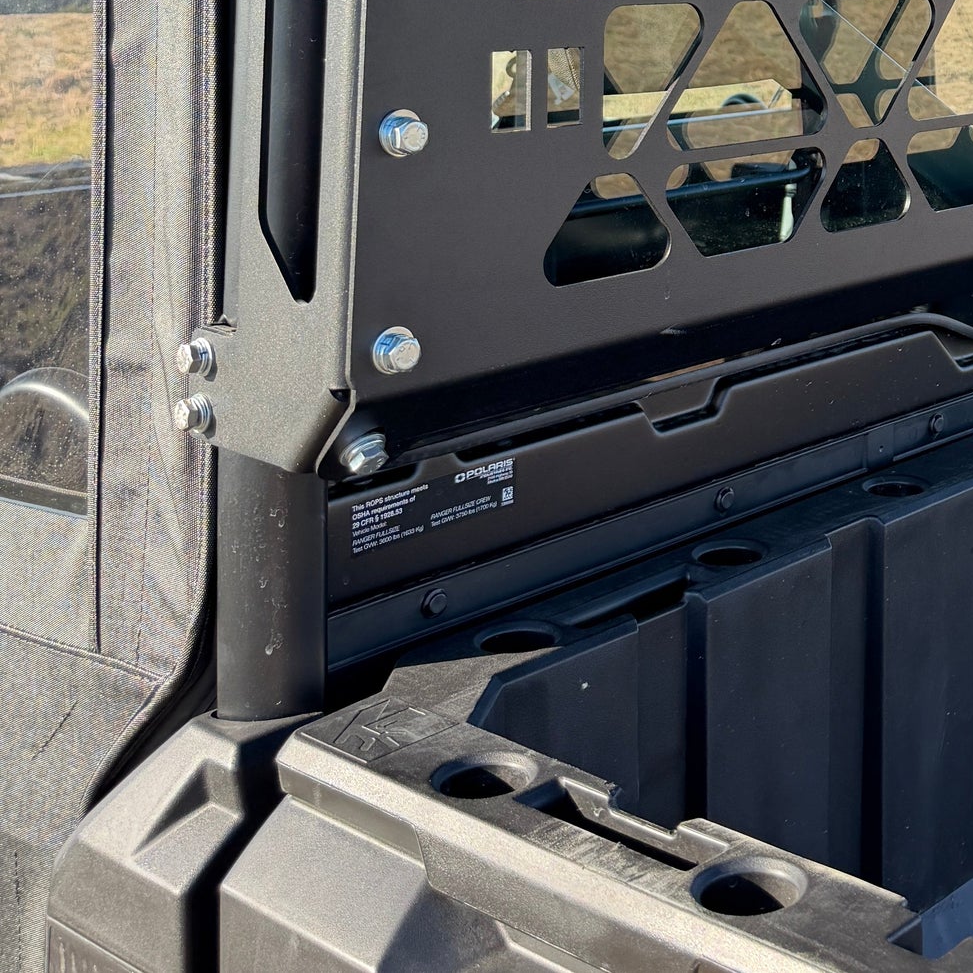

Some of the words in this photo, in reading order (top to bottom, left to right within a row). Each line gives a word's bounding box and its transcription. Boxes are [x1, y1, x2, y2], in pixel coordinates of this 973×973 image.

[467, 458, 513, 478] POLARIS
[352, 504, 364, 512] This
[366, 497, 383, 508] ROPS
[385, 490, 409, 502] structure
[411, 484, 428, 494] meets
[431, 508, 452, 520] RANGER
[453, 500, 475, 512] FULLSIZE
[476, 496, 491, 504] CREW
[352, 511, 370, 520] OSHA
[371, 499, 408, 514] requirements
[353, 527, 369, 537] Vehicle
[361, 518, 374, 526] CFR
[352, 534, 375, 546] RANGER
[376, 525, 400, 538] FULLSIZE
